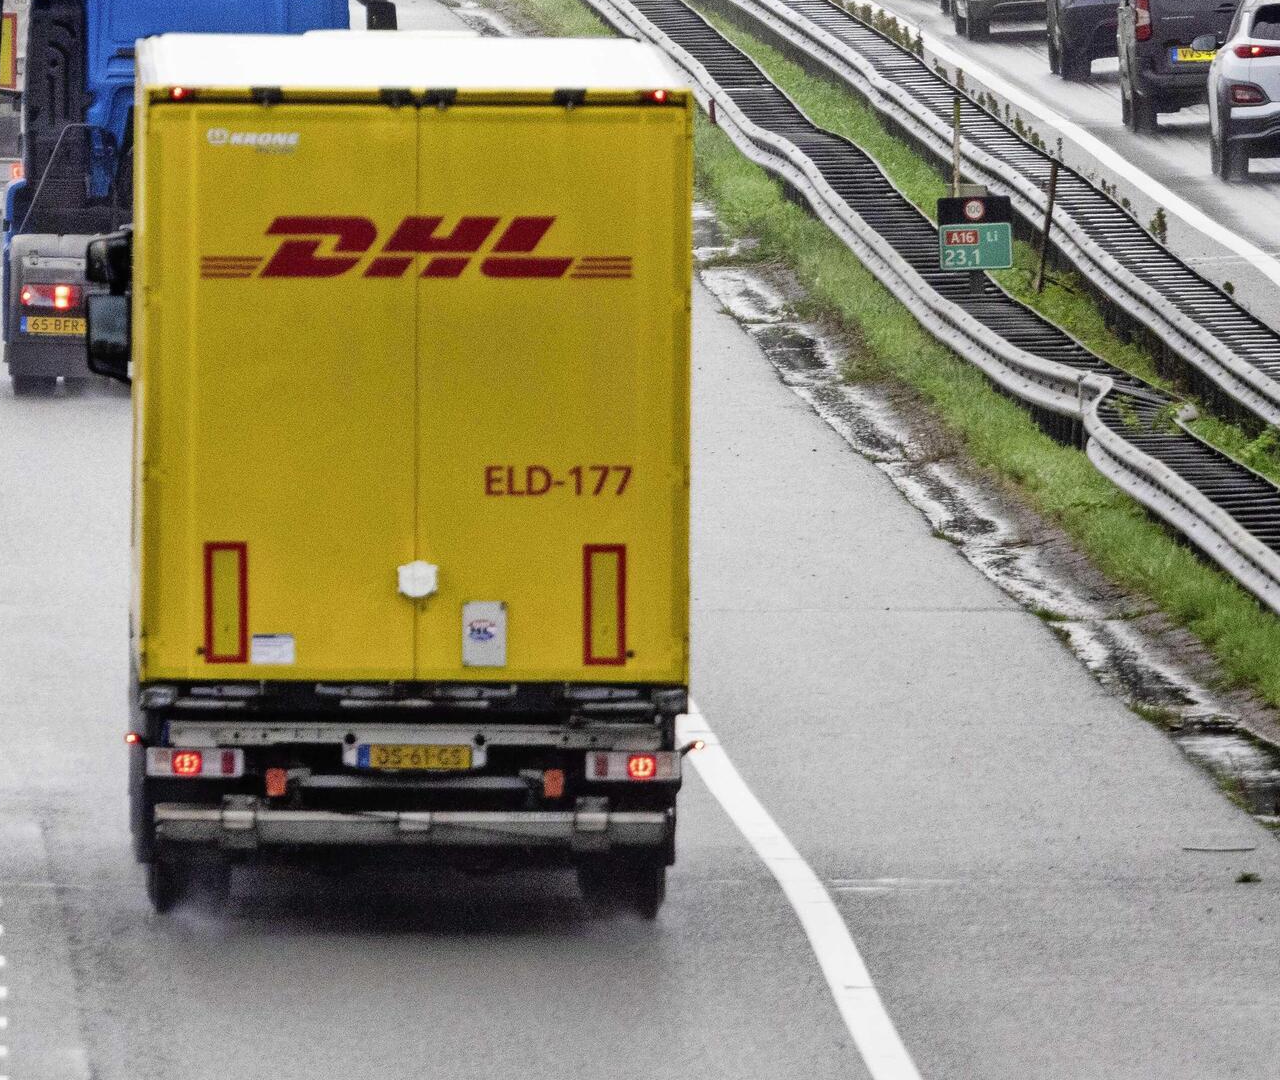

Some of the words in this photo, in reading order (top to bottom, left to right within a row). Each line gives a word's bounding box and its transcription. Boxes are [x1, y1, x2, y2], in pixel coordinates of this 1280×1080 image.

[259, 215, 574, 279] DHL
[950, 231, 975, 244] A16
[985, 230, 999, 243] Li
[31, 319, 85, 332] 65-BFR-
[484, 465, 633, 497] ELD-177
